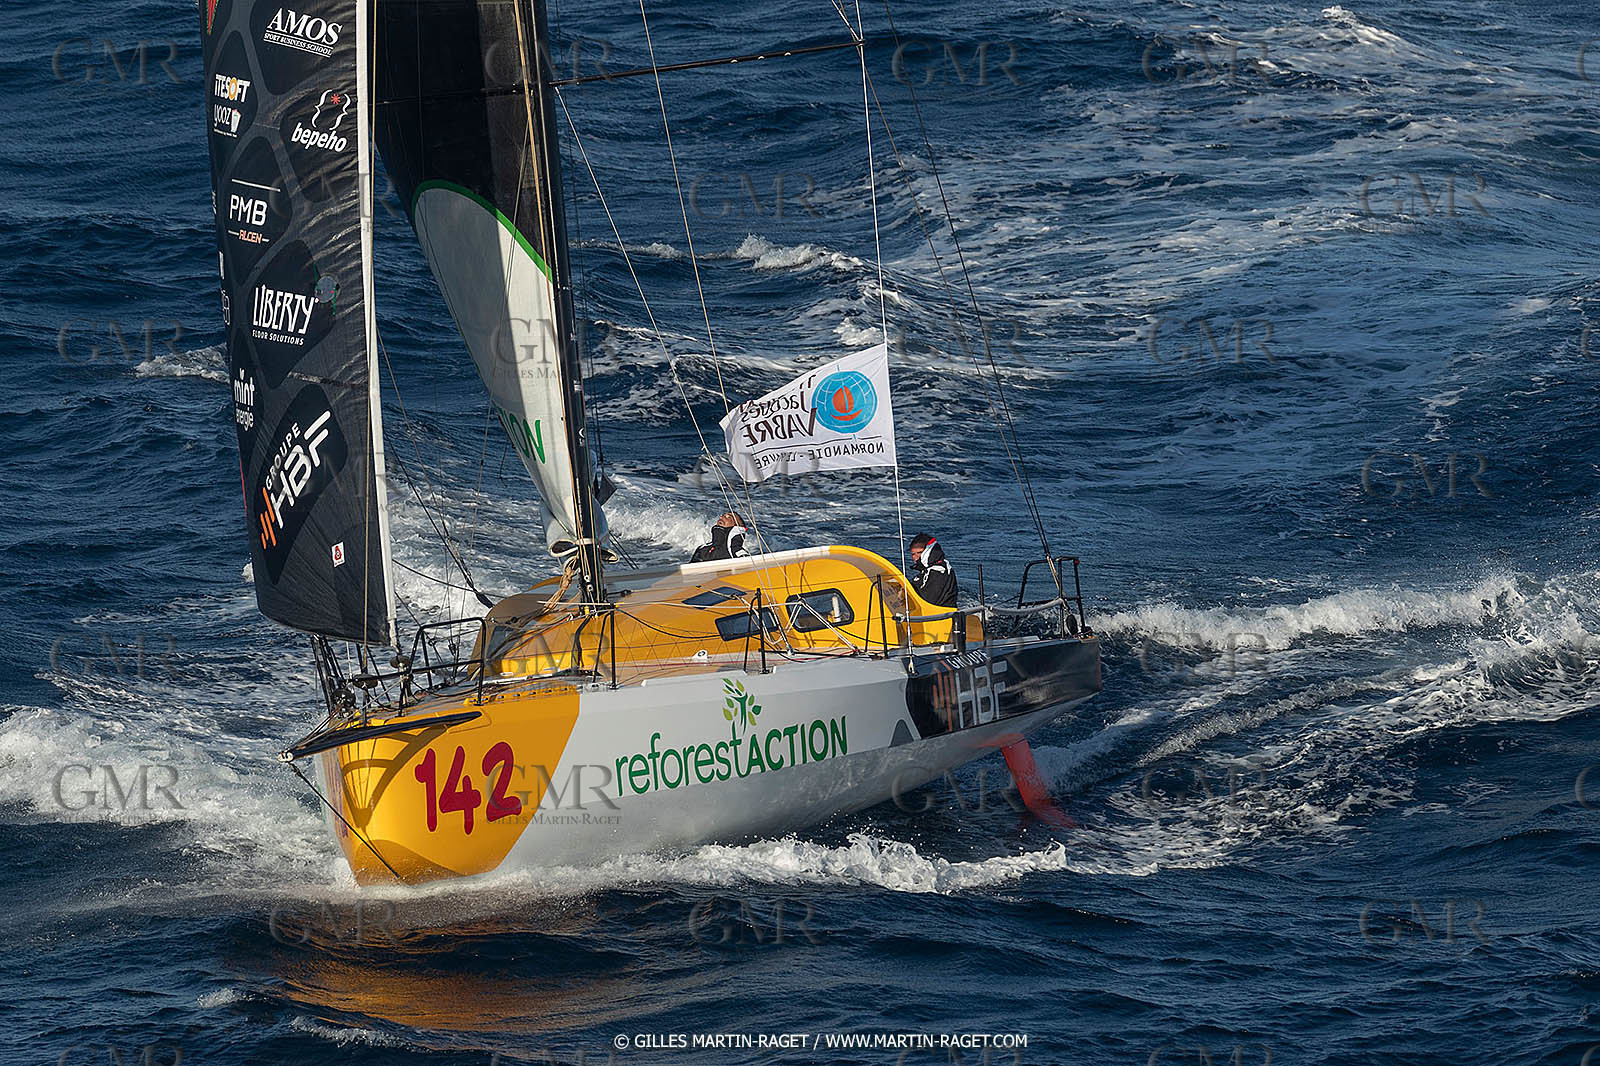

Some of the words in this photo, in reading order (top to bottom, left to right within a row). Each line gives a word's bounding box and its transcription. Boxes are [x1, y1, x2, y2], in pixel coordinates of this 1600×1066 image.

[264, 33, 281, 41] SPORT
[280, 36, 306, 48] BUSINESS
[306, 43, 333, 55] SCHOOL
[267, 8, 343, 45] AMOS
[291, 123, 347, 152] bepeho
[229, 194, 268, 226] PMB
[253, 284, 315, 335] LIBERTY
[252, 329, 268, 340] FLOOR
[269, 333, 304, 346] SOLUTIONS
[234, 371, 255, 407] mint
[266, 422, 300, 490] GROUPE
[271, 410, 331, 529] HBF
[955, 660, 1007, 728] HBF
[615, 715, 848, 797] reforestACTION
[415, 742, 523, 835] 142
